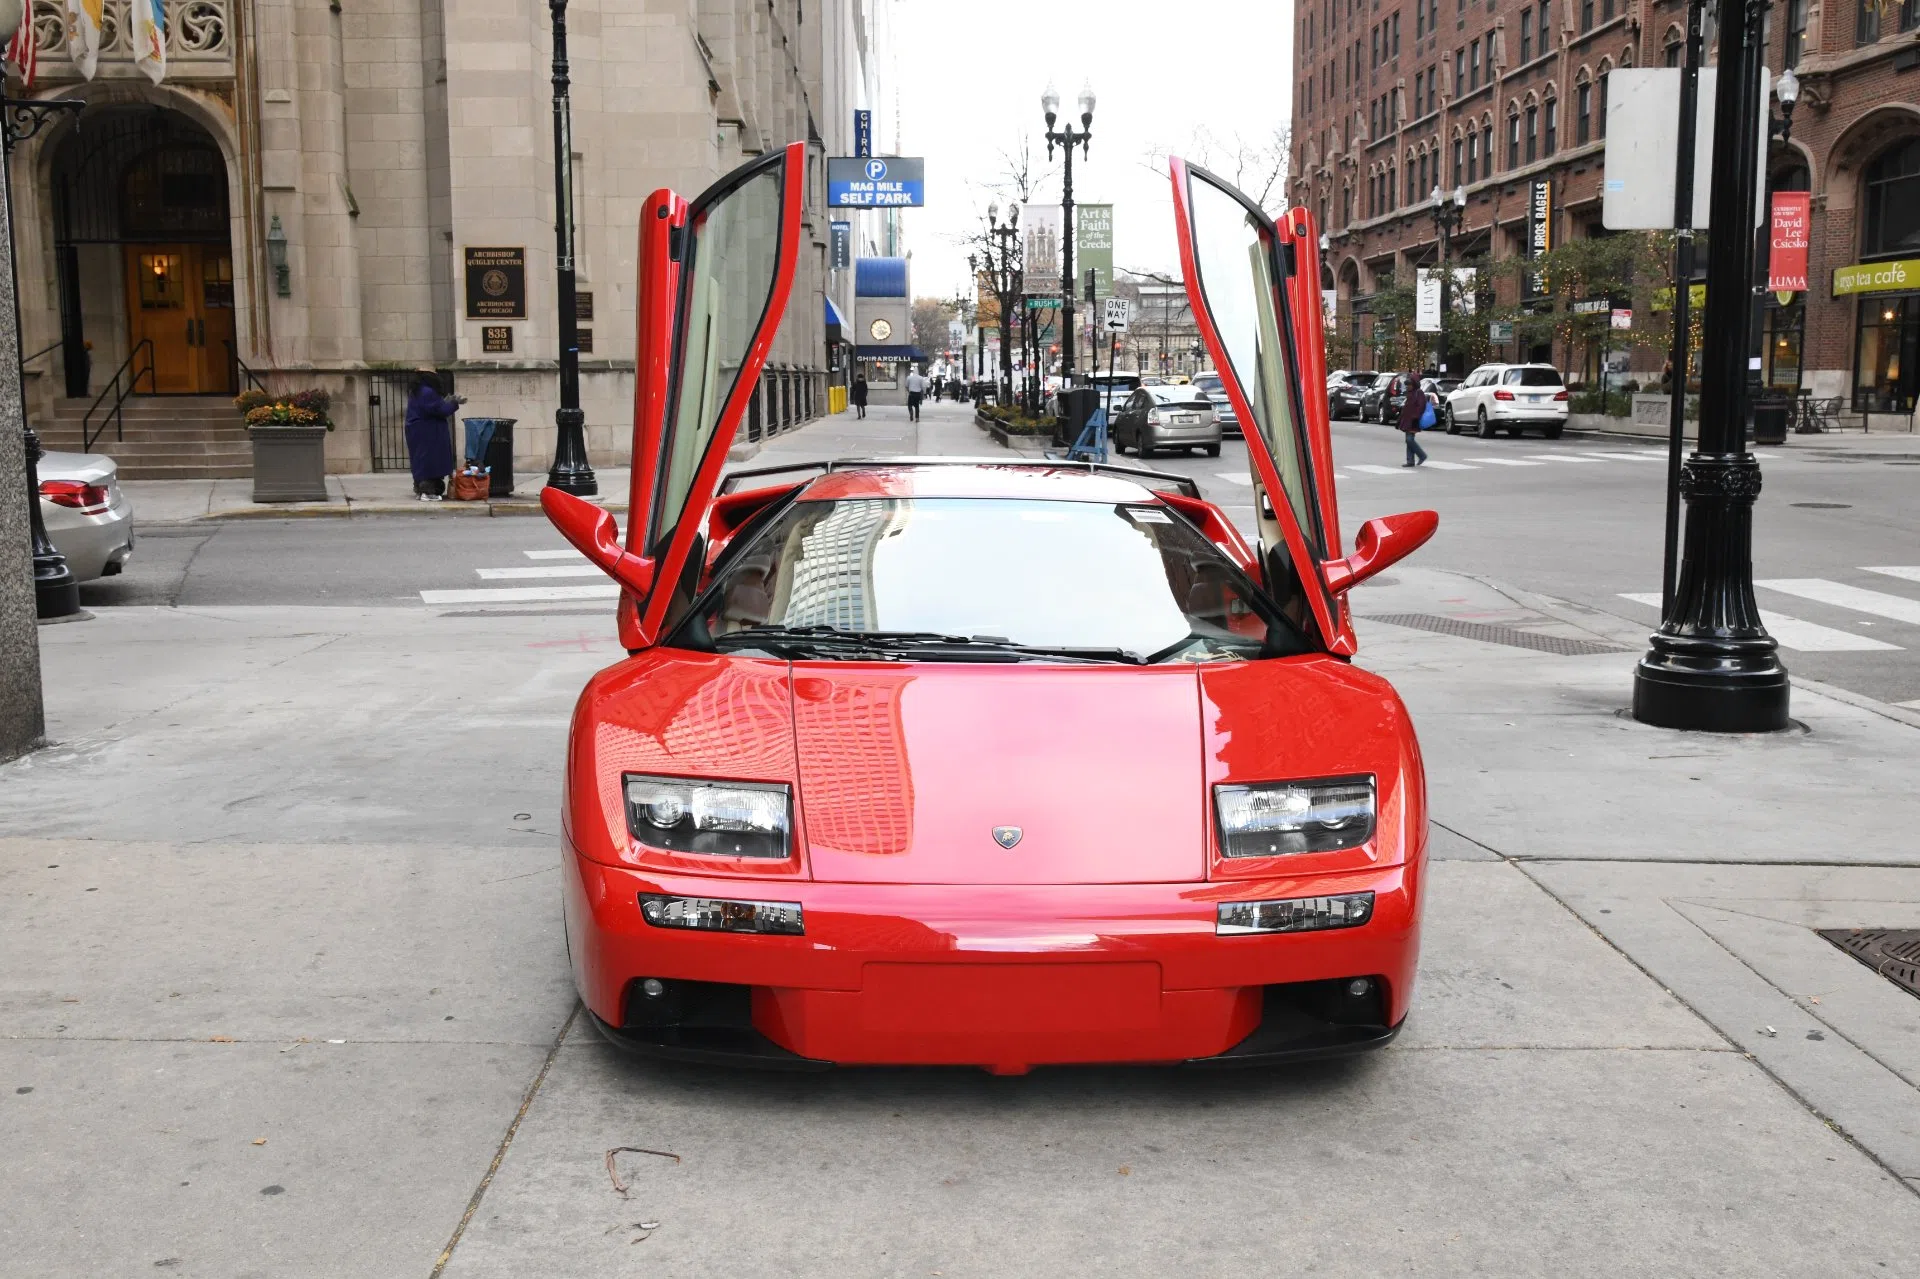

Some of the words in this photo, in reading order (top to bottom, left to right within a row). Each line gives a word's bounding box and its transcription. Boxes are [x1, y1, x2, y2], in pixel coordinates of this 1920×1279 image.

[850, 182, 875, 191] MAG
[877, 182, 903, 191] MILE
[840, 192, 873, 203] SELF
[876, 192, 912, 203] PARK
[1535, 183, 1548, 219] BAGELS
[1080, 208, 1099, 219] Art
[1102, 209, 1110, 219] &
[1080, 220, 1110, 231] Faith
[1774, 218, 1802, 228] David
[1086, 232, 1094, 240] of
[1094, 231, 1105, 239] the
[1785, 228, 1802, 238] Lee
[1079, 240, 1112, 249] Creche
[1773, 238, 1808, 249] Csicsko
[1857, 271, 1871, 286] tea
[1874, 262, 1906, 284] café
[1768, 276, 1806, 287] LUMA
[1034, 300, 1053, 308] RUSH
[1108, 300, 1127, 310] ONE
[1107, 310, 1126, 319] WAY
[487, 328, 507, 339] 835
